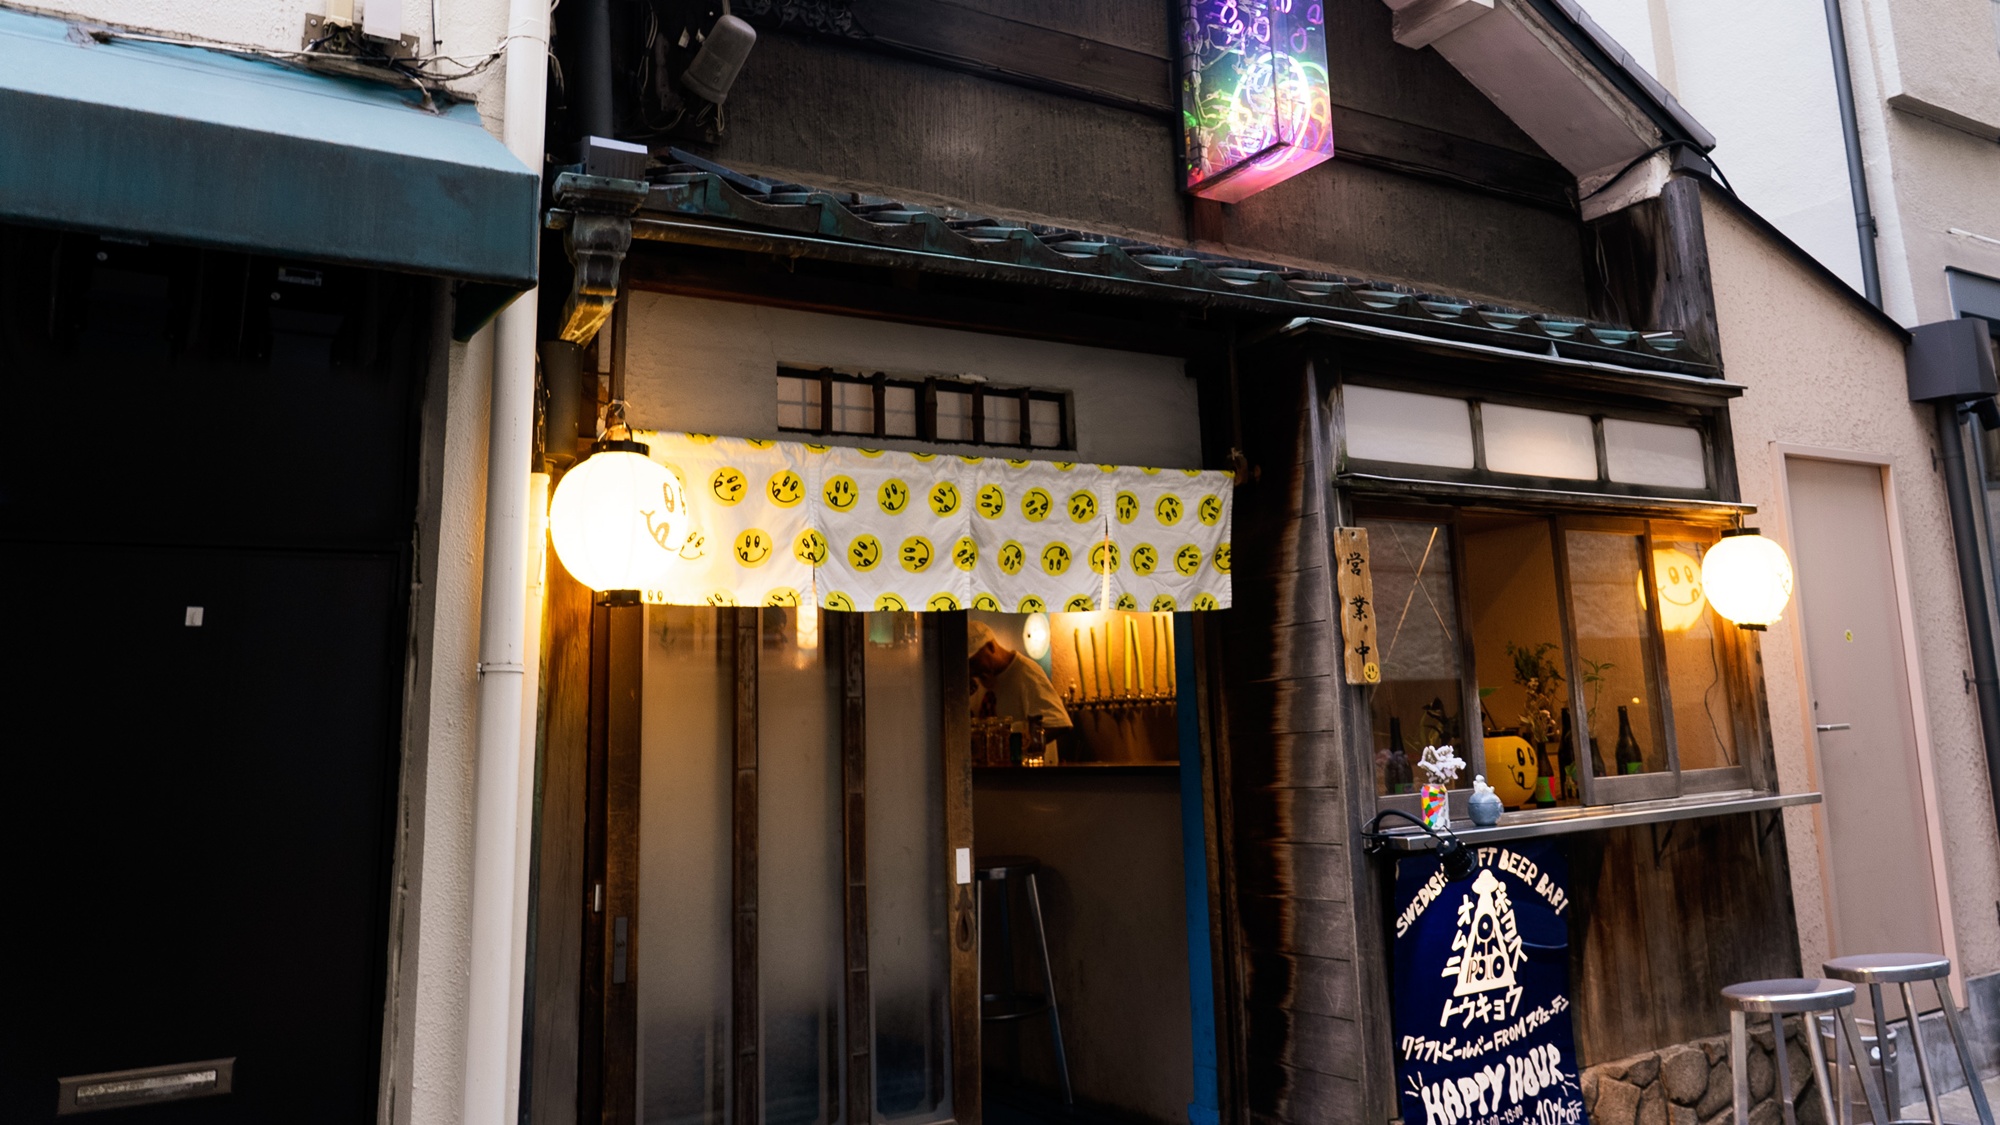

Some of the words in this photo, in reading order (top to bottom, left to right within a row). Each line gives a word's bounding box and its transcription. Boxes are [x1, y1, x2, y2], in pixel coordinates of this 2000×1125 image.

[1346, 552, 1370, 667] 営業中
[1396, 862, 1449, 938] SWEDISH
[1498, 849, 1538, 886] BEER
[1535, 873, 1569, 916] BAR!
[1440, 984, 1524, 1029] トウキョウ
[1493, 1017, 1527, 1052] FROM
[1421, 1063, 1505, 1125] HAPPY
[1506, 1043, 1565, 1104] HOUR
[1536, 1097, 1566, 1125] 10%
